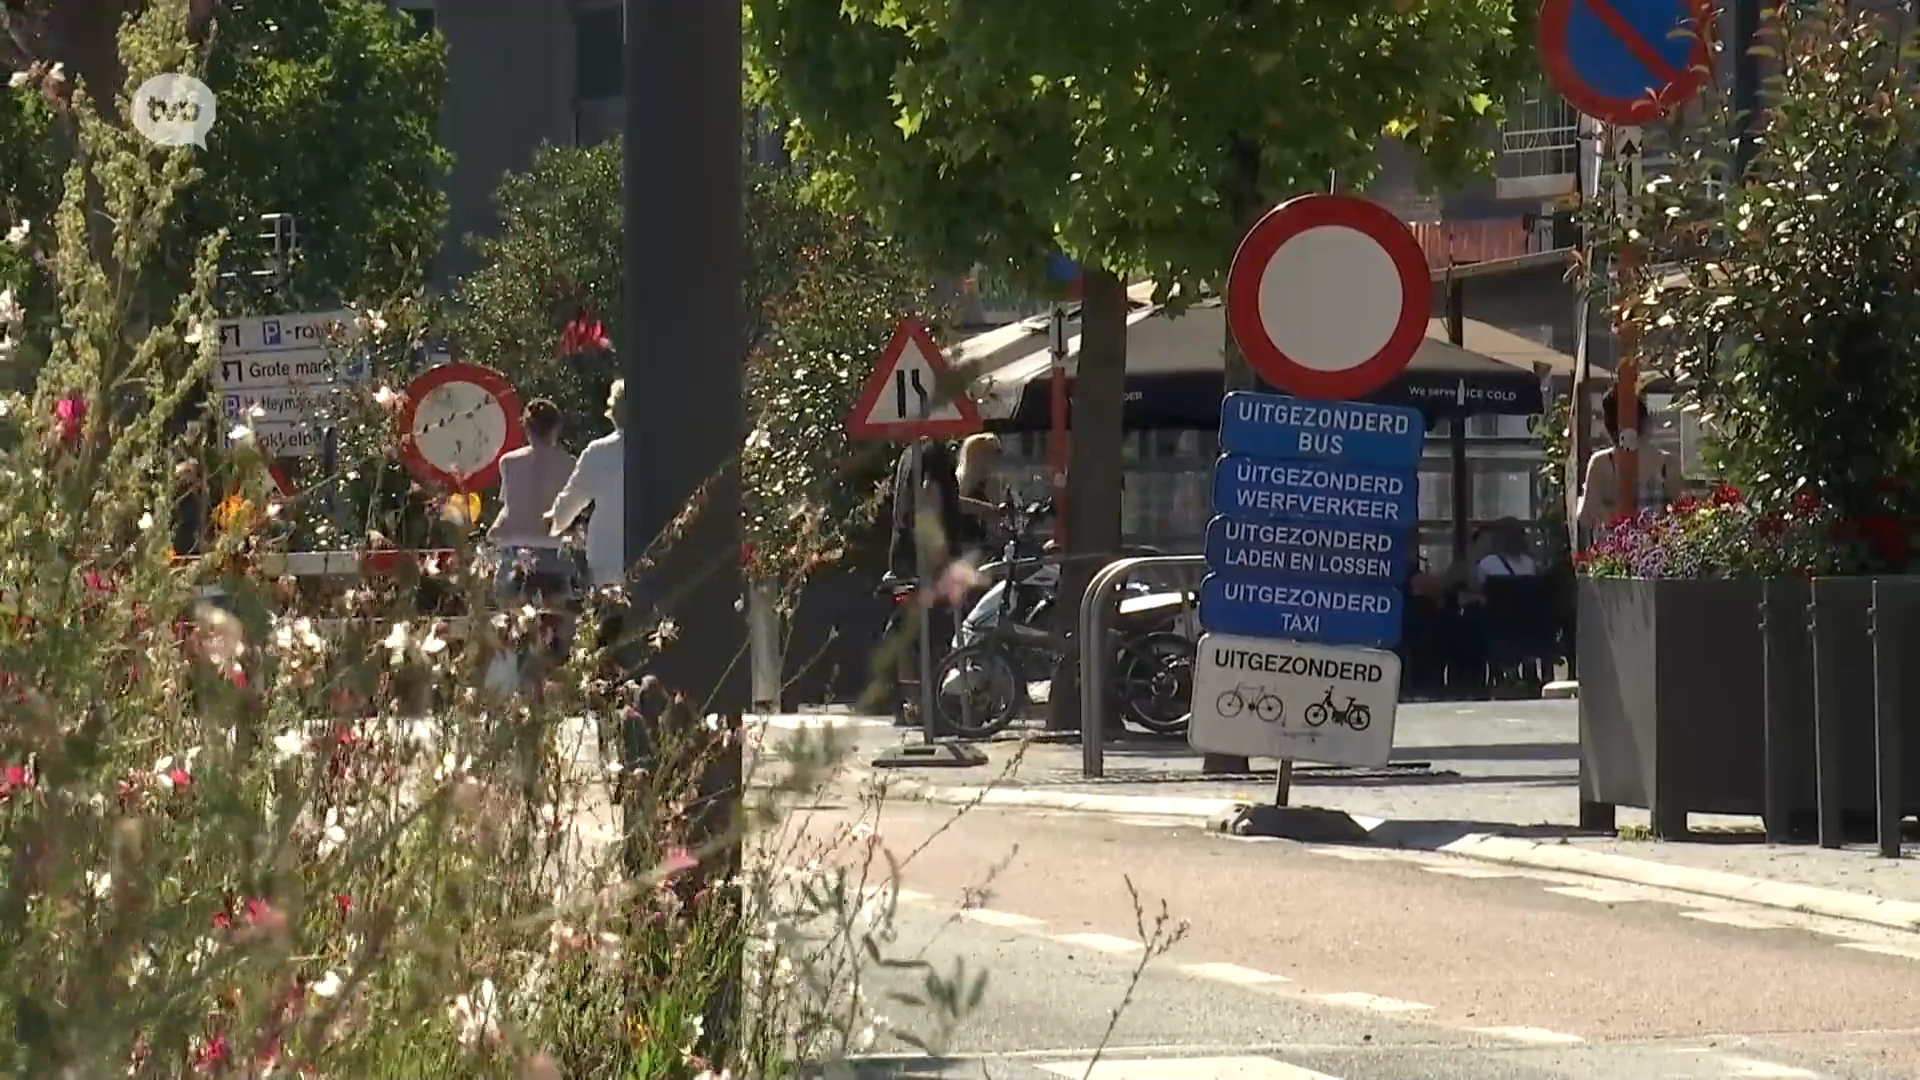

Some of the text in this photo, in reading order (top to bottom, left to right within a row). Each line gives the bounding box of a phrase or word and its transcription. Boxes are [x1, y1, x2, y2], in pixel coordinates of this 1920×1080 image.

[249, 361, 290, 378] Grote
[1409, 386, 1517, 402] We serve ICE COLD
[1238, 401, 1409, 434] UITGEZONDERD
[1298, 432, 1344, 454] BUS
[1236, 464, 1403, 494] UITGEZONDERD
[1236, 489, 1399, 520] WERFVERKEER
[1225, 522, 1392, 551] UITGEZONDERD
[1225, 548, 1391, 577] LADEN EN LOSSEN
[1224, 583, 1391, 614] UITGEZONDERD
[1281, 613, 1320, 633] TAXI
[1215, 649, 1382, 683] UITGEZONDERD
